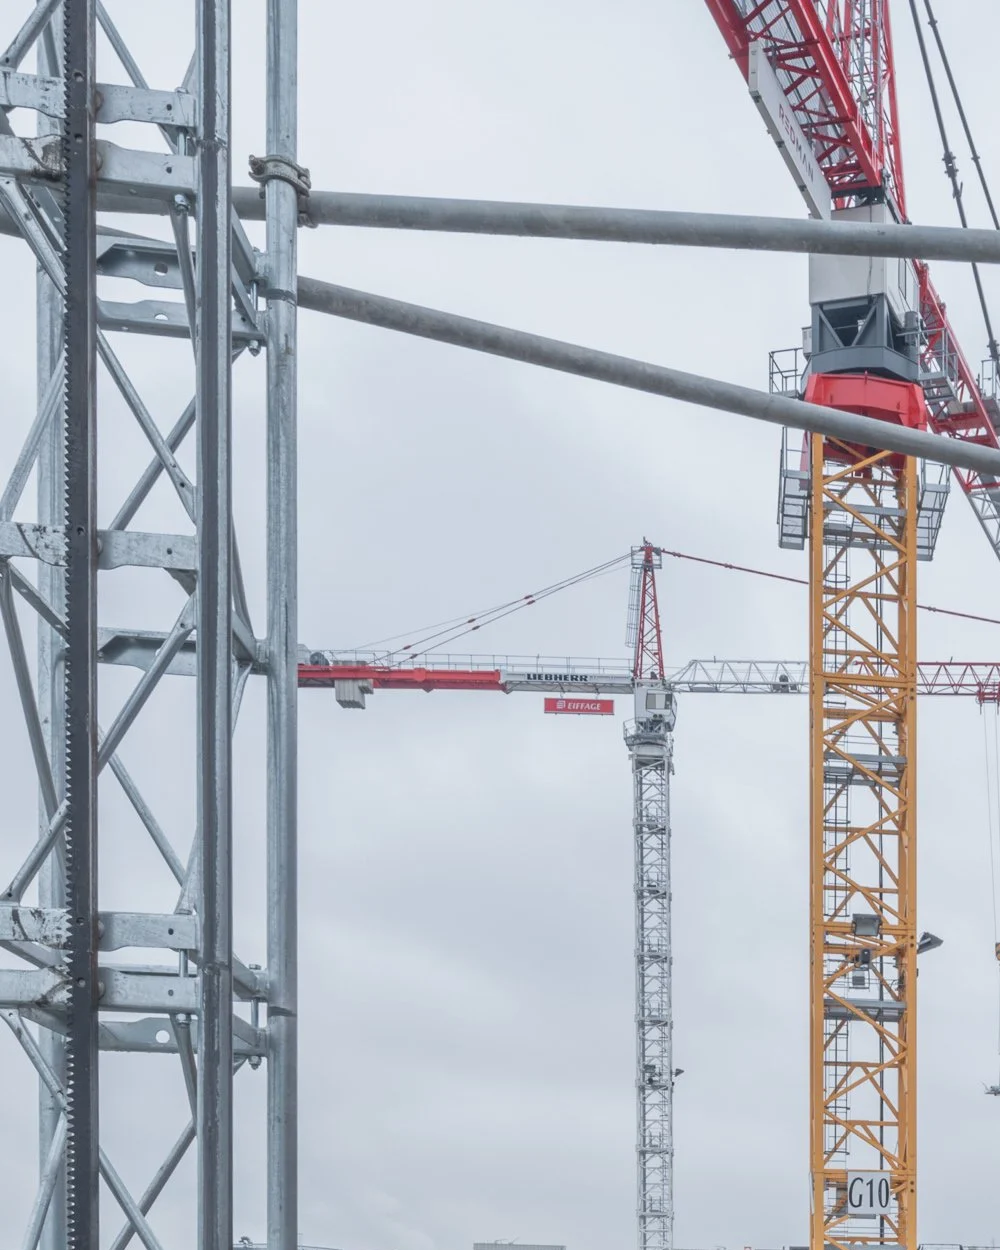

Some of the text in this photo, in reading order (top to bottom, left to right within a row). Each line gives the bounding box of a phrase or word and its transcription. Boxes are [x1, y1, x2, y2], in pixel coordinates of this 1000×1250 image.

[526, 673, 588, 682] LIEBHERR
[567, 701, 601, 711] EIFFAGE
[848, 1177, 890, 1208] G10
